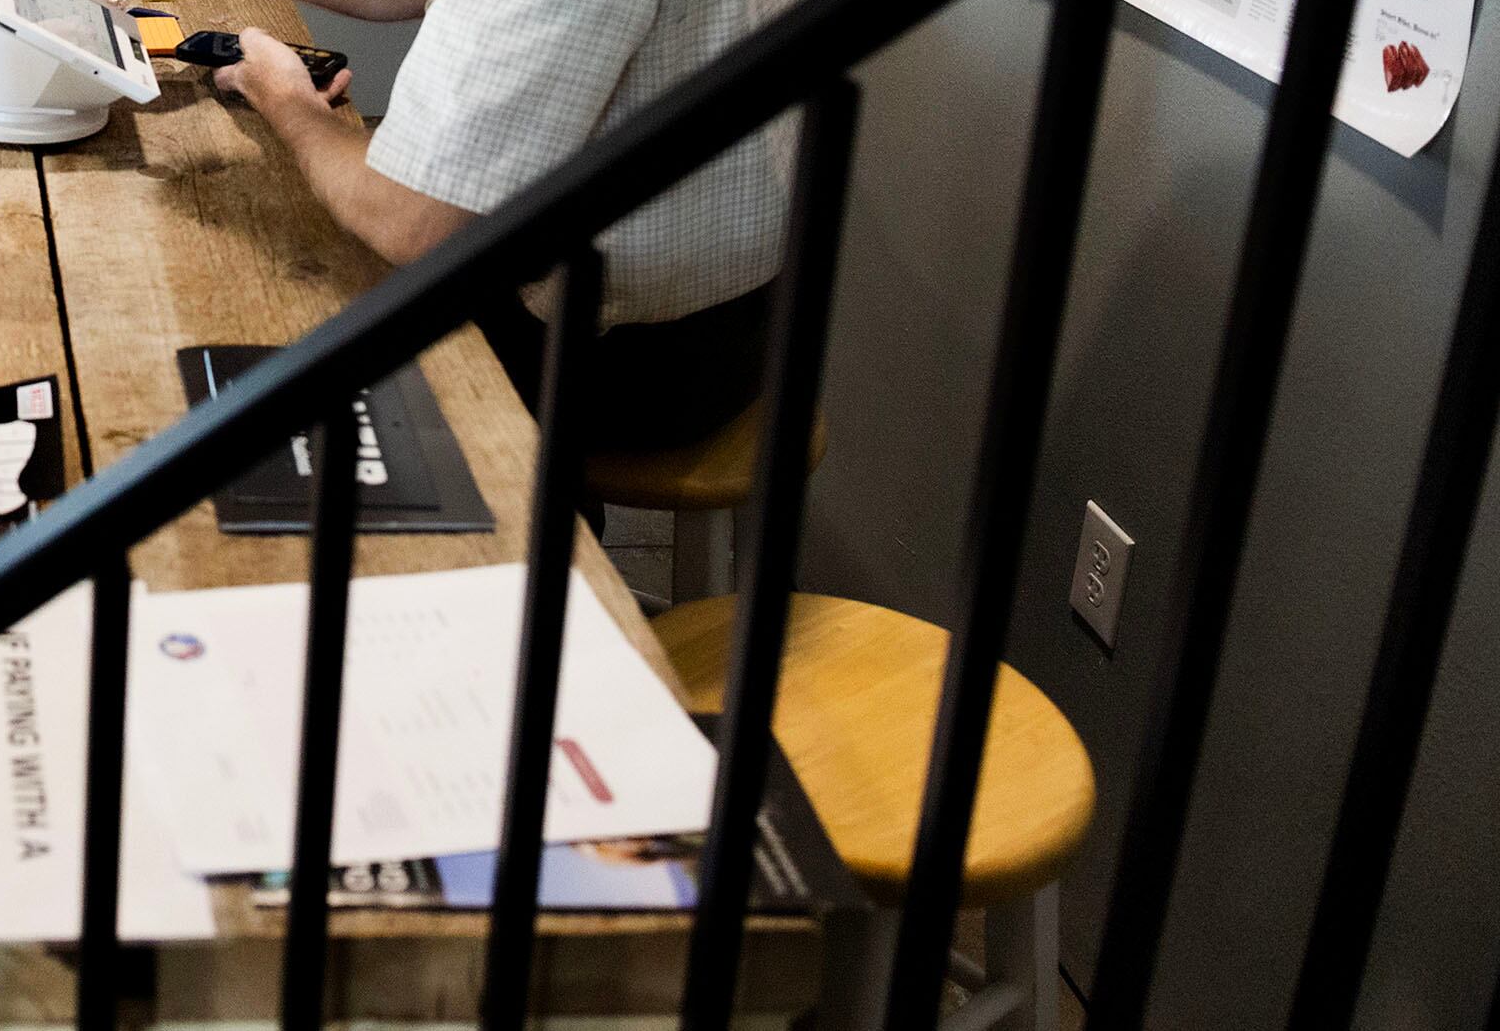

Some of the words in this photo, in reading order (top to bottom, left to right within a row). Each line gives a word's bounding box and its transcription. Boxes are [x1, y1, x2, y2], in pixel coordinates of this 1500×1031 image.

[1381, 9, 1394, 23] Short
[2, 657, 40, 745] PAYING
[11, 755, 46, 828] WITH
[20, 840, 51, 859] A
